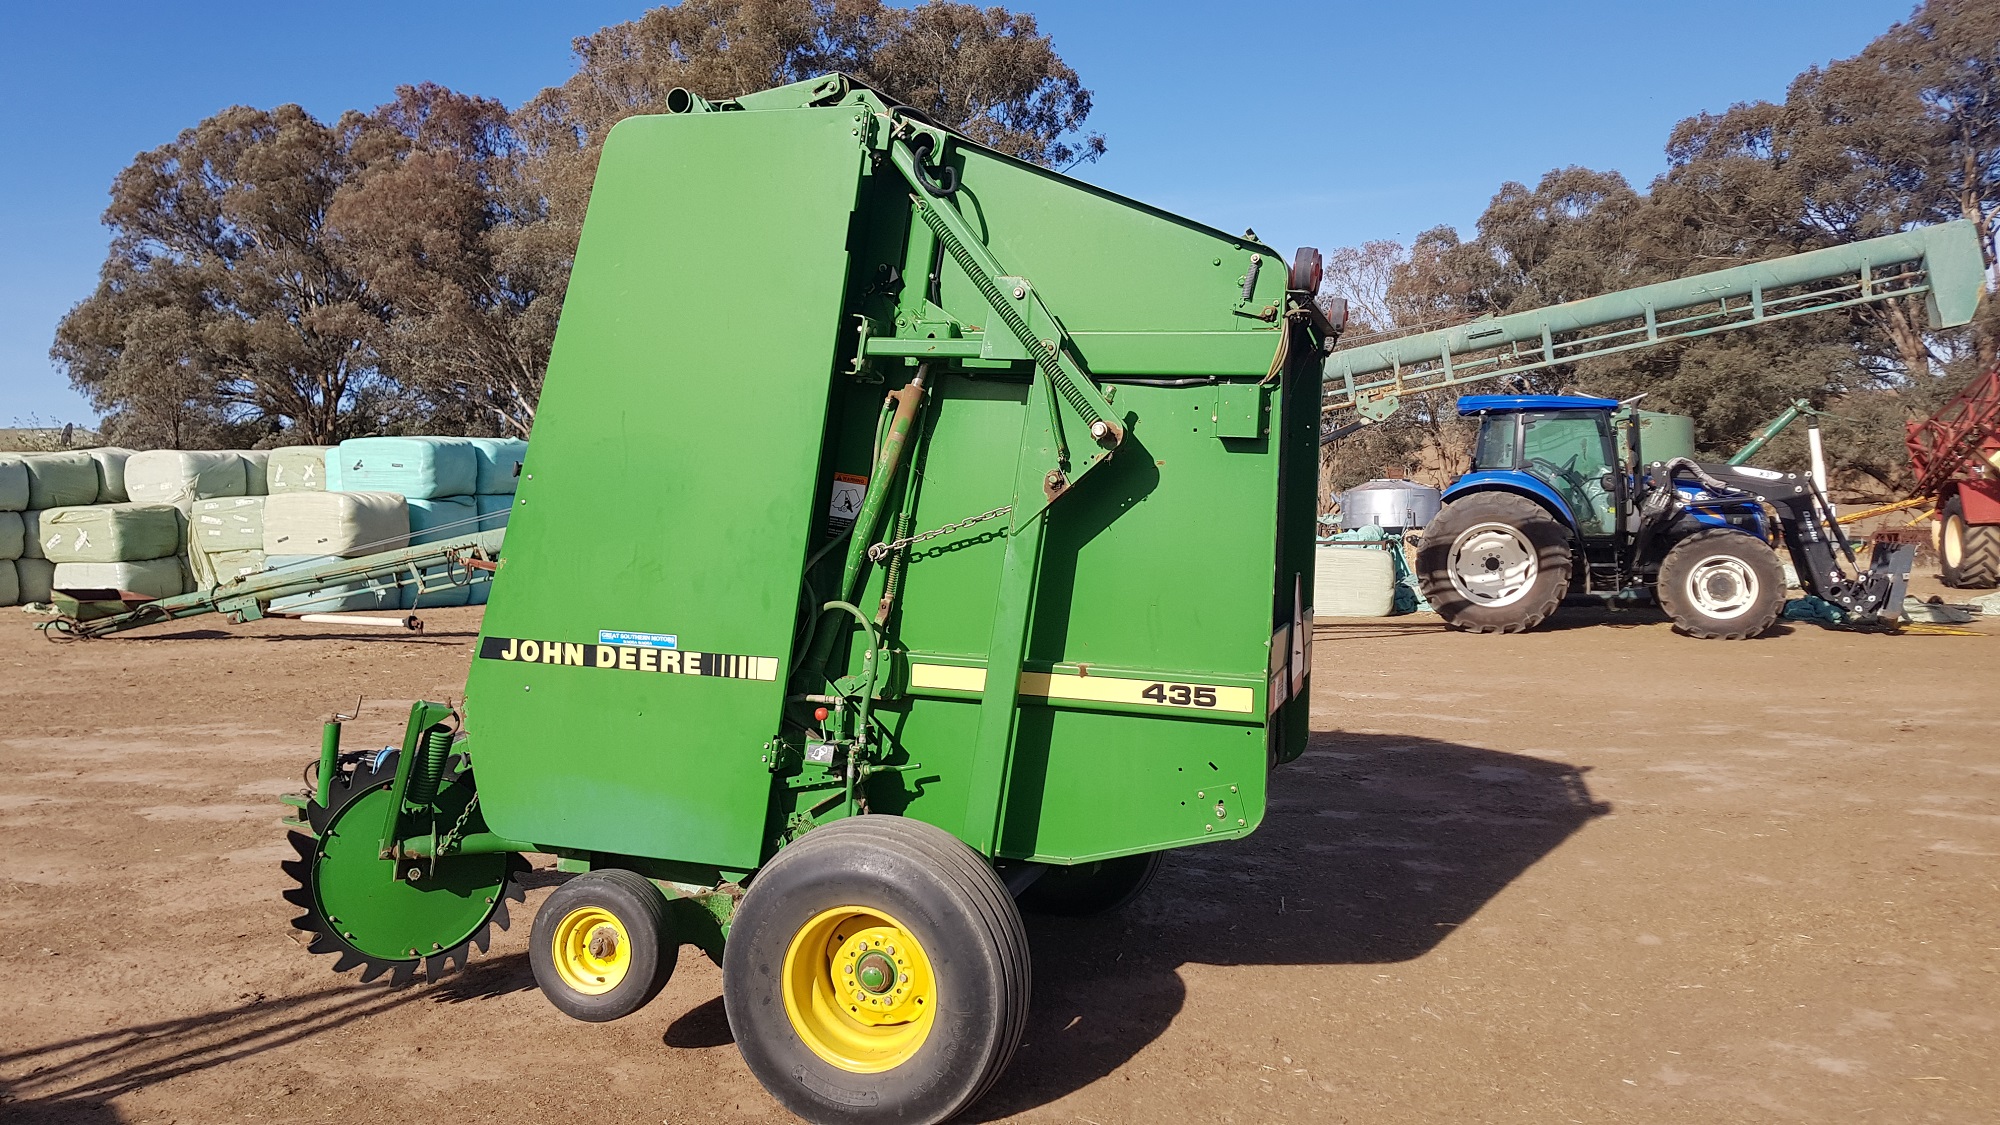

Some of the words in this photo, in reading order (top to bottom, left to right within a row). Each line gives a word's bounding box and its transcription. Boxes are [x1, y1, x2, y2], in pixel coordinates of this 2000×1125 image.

[842, 476, 865, 484] WARNING
[651, 635, 675, 644] MOTORS
[501, 638, 585, 667] JOHN
[596, 645, 702, 675] DEERE
[1141, 683, 1217, 707] 435
